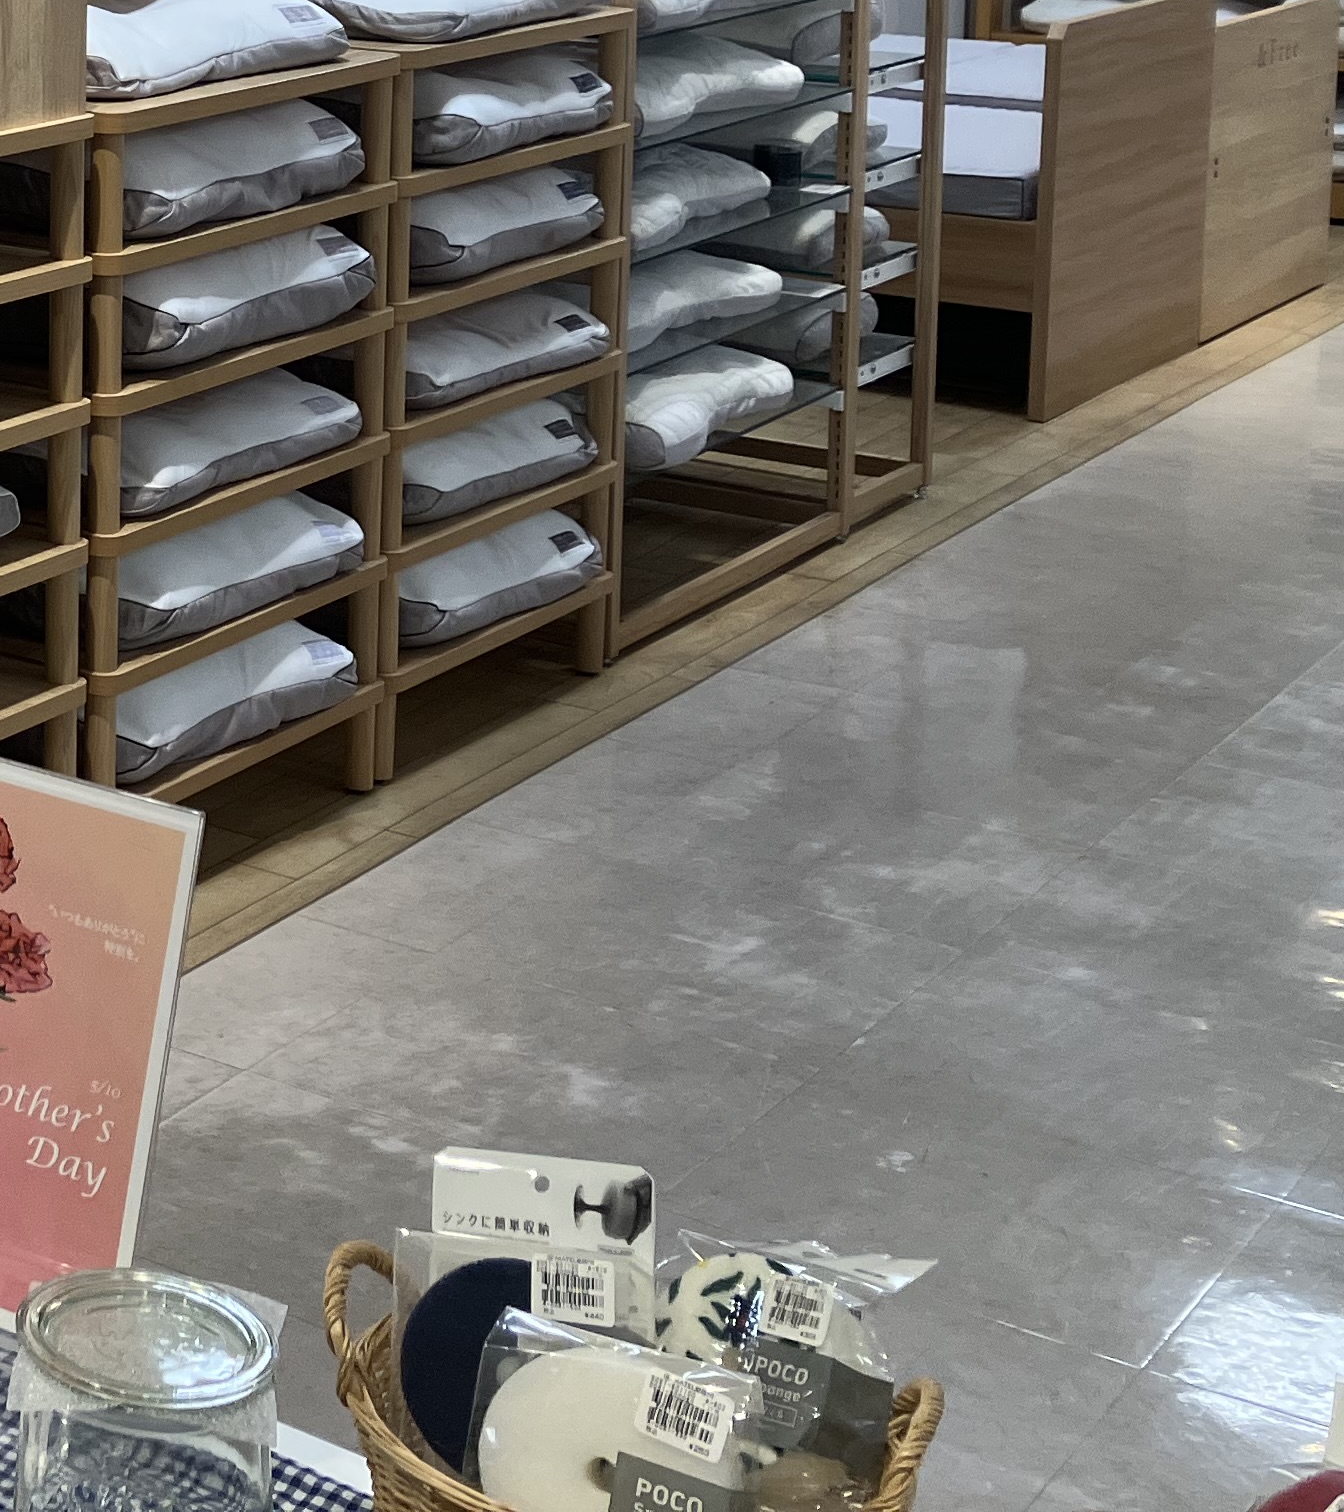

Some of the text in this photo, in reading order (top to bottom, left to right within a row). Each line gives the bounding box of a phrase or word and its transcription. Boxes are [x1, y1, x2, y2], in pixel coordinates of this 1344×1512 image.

[26, 1136, 108, 1198] Day
[442, 1210, 550, 1237] シンクに簡単収納
[754, 1355, 810, 1386] POCO
[635, 1477, 704, 1512] POCO
